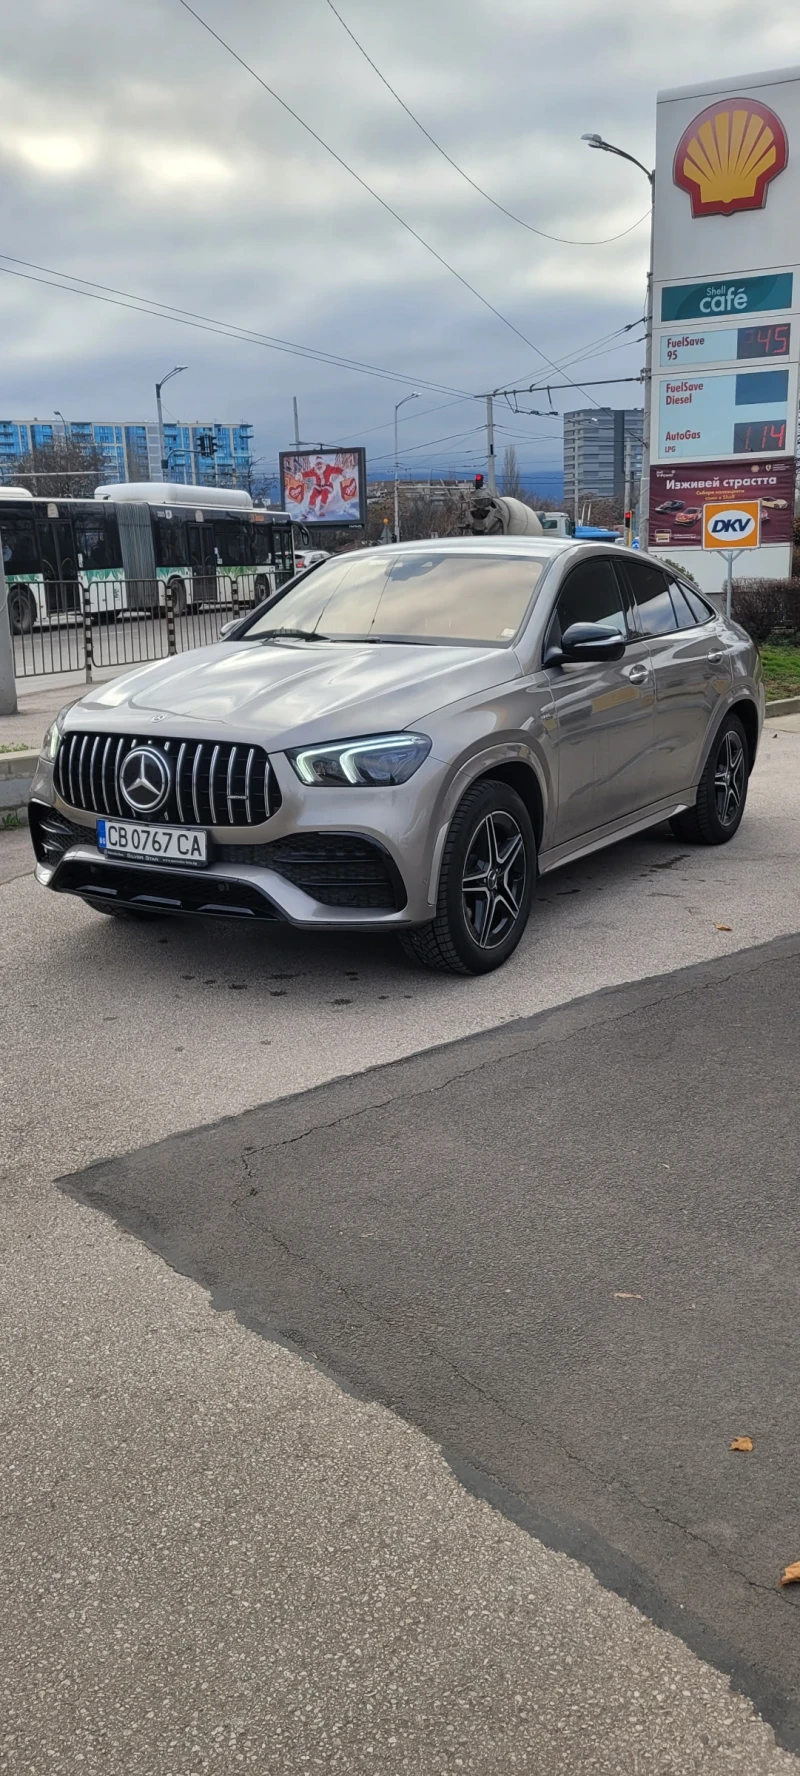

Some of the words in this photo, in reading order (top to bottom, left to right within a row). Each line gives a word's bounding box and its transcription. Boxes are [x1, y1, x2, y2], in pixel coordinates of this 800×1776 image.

[706, 286, 726, 297] Shell
[699, 287, 748, 313] café
[666, 336, 705, 348] FuelSave
[667, 350, 678, 361] 95
[665, 381, 704, 394] FuelSave
[665, 393, 693, 405] Diesel
[665, 430, 701, 442] AutoGas
[666, 477, 720, 490] Изживей
[723, 476, 777, 490] страстта
[711, 517, 753, 534] DKV
[108, 825, 128, 848] CB
[131, 828, 173, 853] 0767
[177, 833, 202, 857] CA
